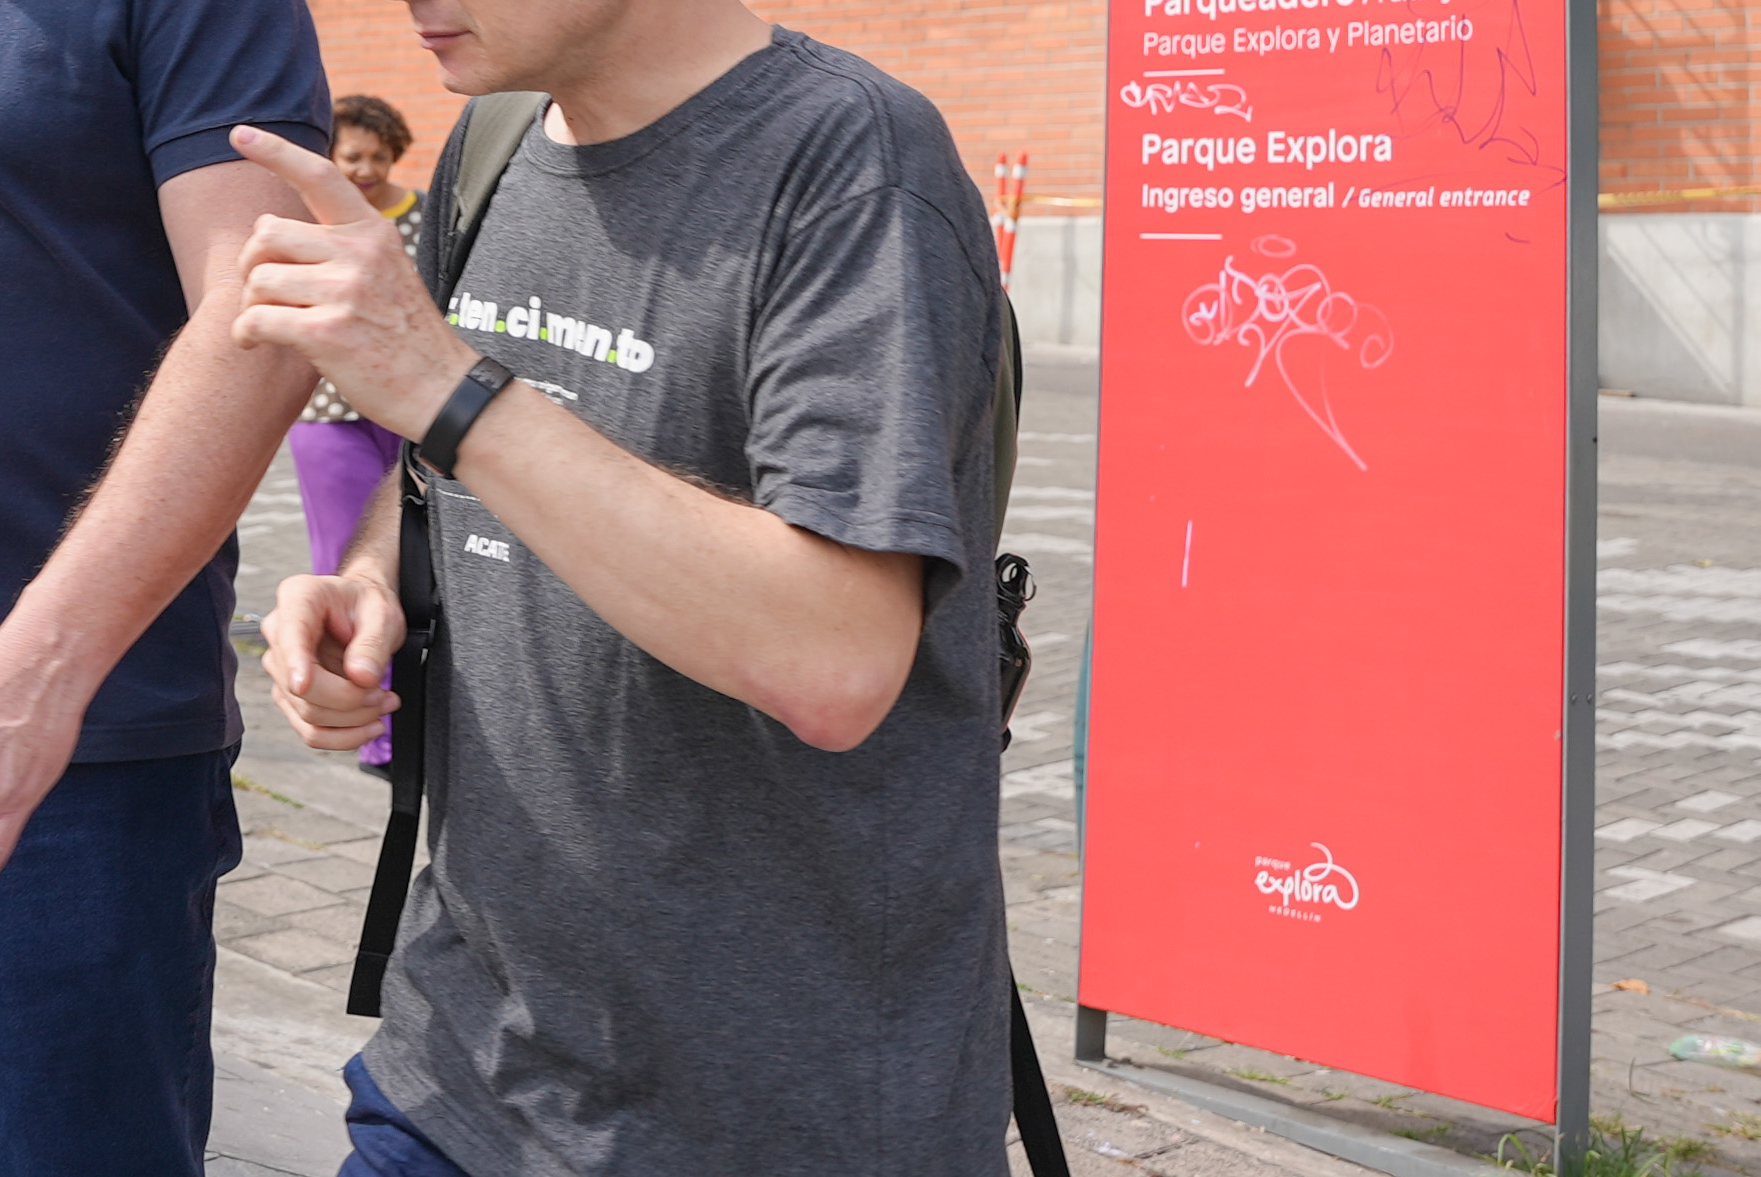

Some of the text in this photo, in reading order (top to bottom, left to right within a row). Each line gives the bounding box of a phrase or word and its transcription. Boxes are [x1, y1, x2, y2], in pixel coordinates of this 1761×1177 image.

[1143, 15, 1473, 60] Parque Explora y Planetario
[1141, 128, 1392, 171] Parque Explora
[1141, 183, 1234, 214] Ingreso
[1240, 181, 1334, 214] general
[1358, 186, 1435, 208] General
[1439, 187, 1531, 207] entrance
[464, 535, 510, 562] ACATE
[1254, 842, 1360, 910] explora
